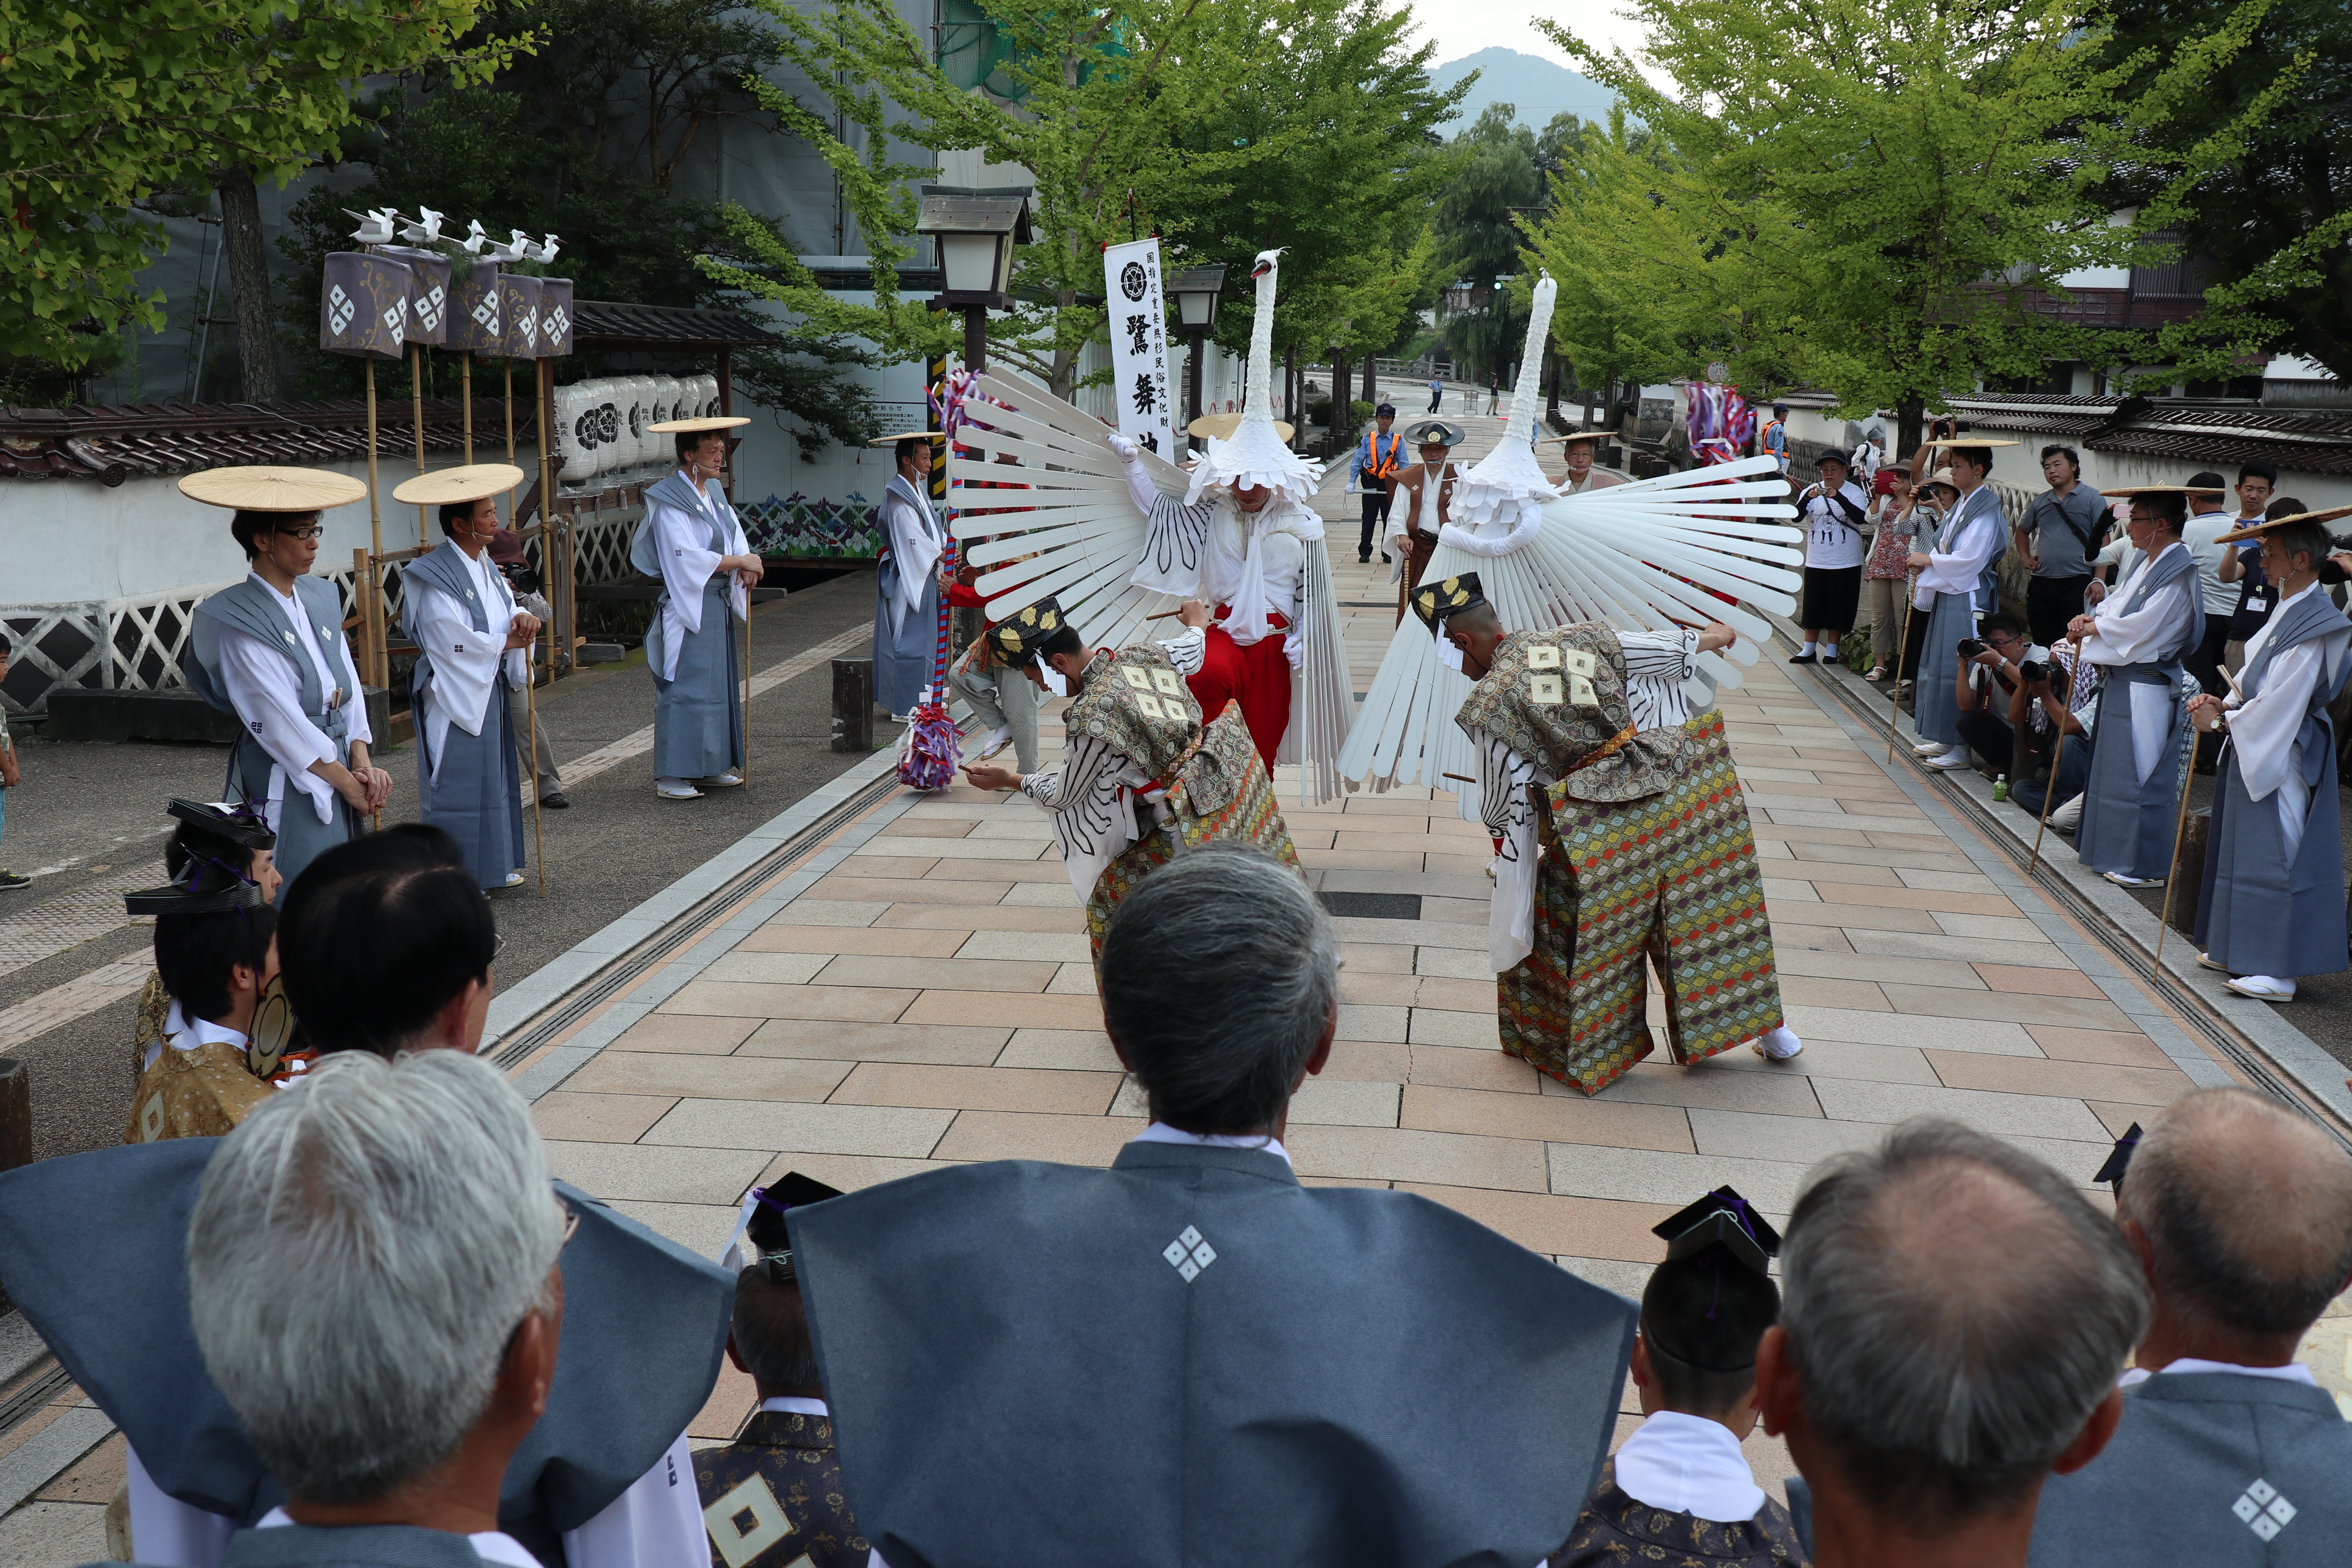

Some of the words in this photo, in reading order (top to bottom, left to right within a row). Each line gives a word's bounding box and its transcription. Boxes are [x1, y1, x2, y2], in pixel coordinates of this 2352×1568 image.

[1147, 252, 1168, 427] 国指定重要無形民俗文化財
